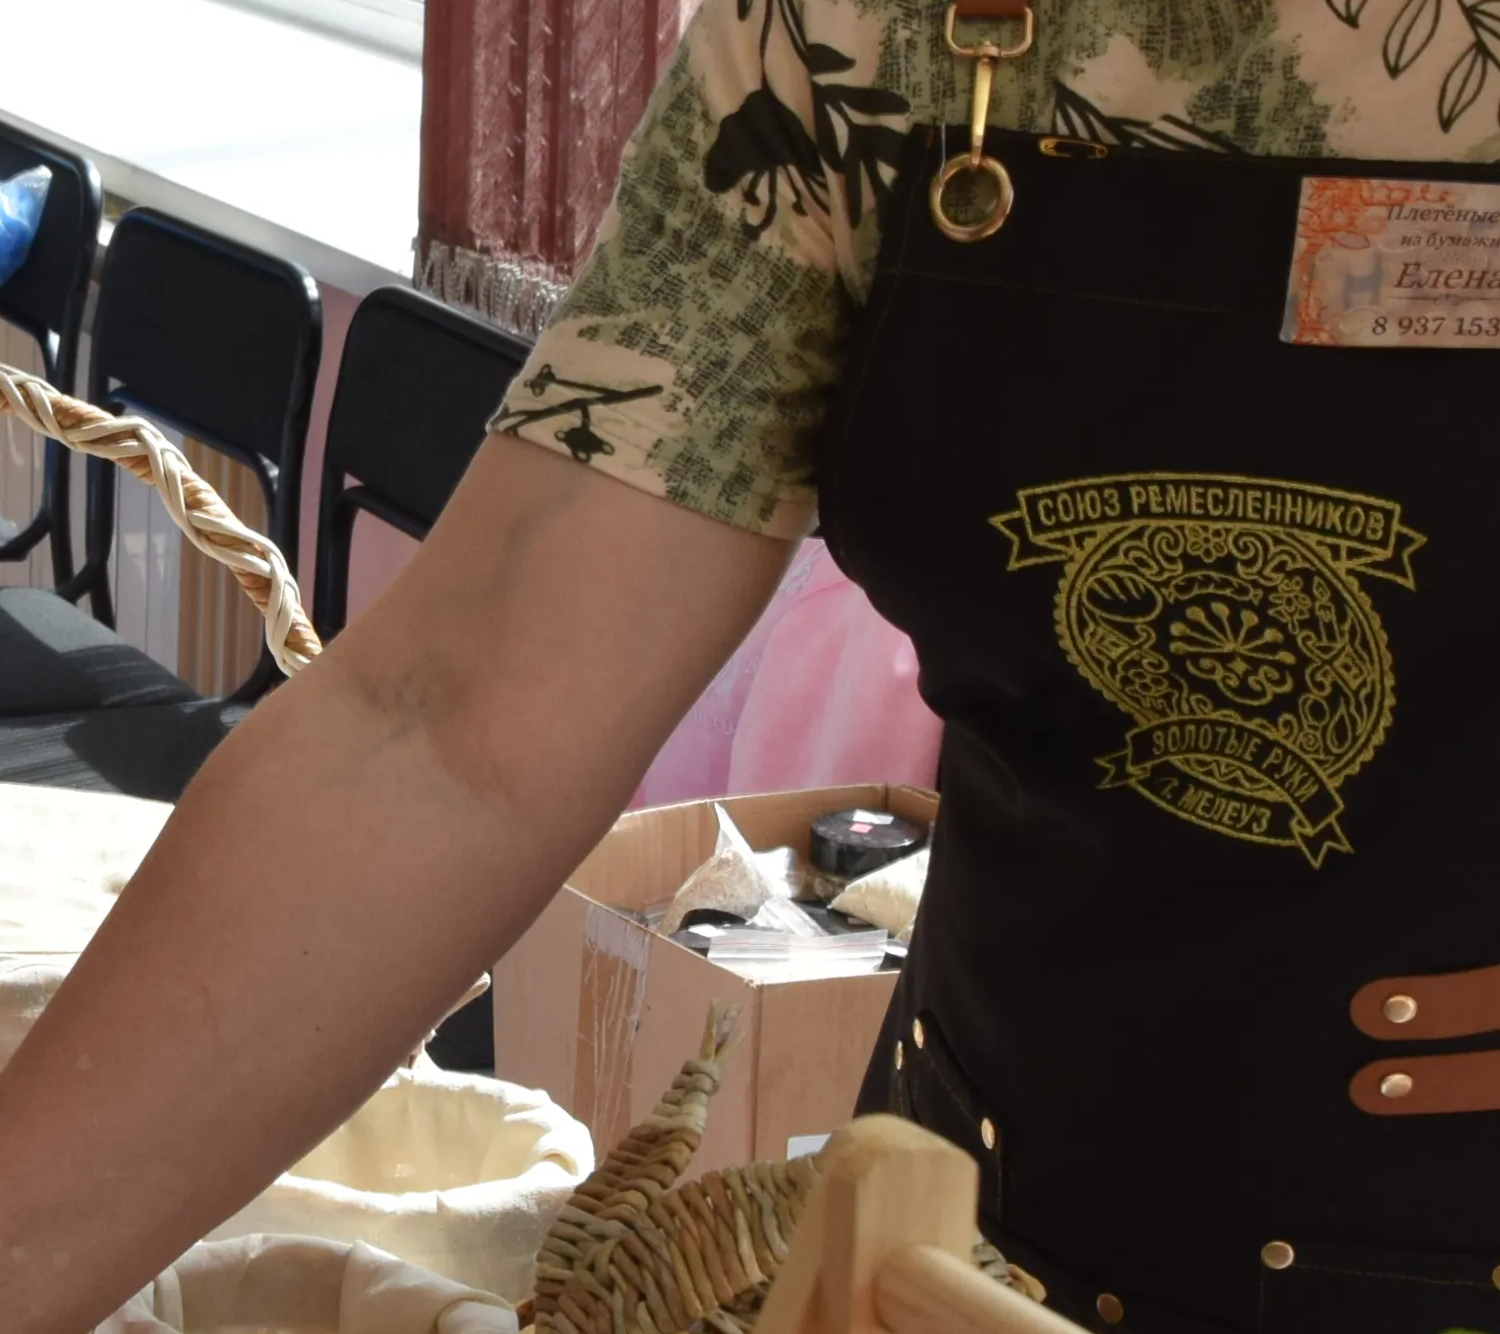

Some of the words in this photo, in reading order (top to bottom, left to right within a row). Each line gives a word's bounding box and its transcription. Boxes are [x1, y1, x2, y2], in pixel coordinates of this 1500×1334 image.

[1386, 204, 1500, 223] Плетёные
[1371, 316, 1388, 336] 8
[1398, 316, 1446, 336] 937
[1453, 316, 1500, 336] 153
[1037, 487, 1121, 527] СОЮЗ
[1128, 484, 1386, 541] РЕМЕСЛЕННИКОВ
[1152, 723, 1262, 761] ЗОЛОТЫЕ
[1261, 747, 1319, 803] РУКИ
[1177, 783, 1271, 833] МЕЛЕУЗ
